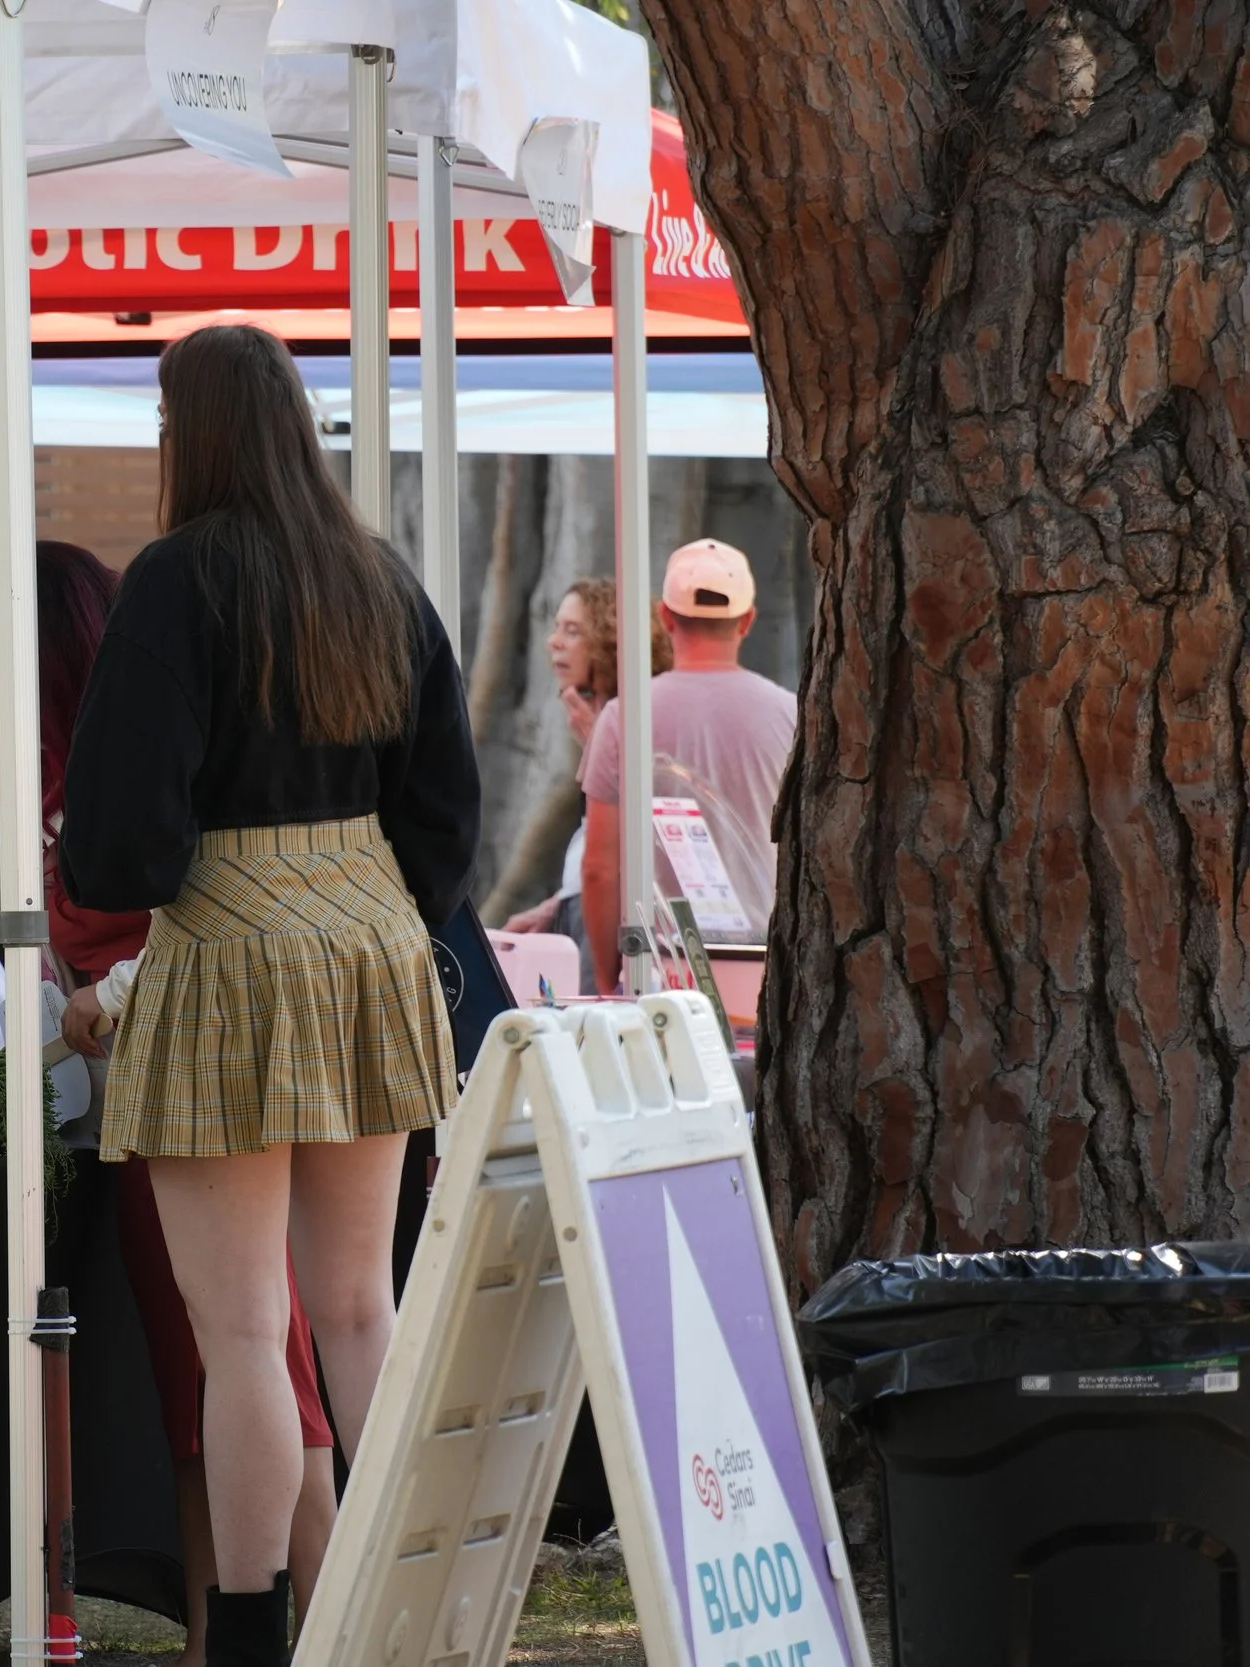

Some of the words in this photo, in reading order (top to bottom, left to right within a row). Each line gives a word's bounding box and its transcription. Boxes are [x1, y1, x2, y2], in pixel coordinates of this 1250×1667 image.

[167, 70, 229, 110] UNCOVERING
[226, 75, 247, 112] YOU
[651, 188, 691, 278] Live
[690, 201, 711, 278] &
[715, 1446, 754, 1477] Cedars
[726, 1479, 756, 1511] Sinai
[696, 1541, 803, 1635] BLOOD
